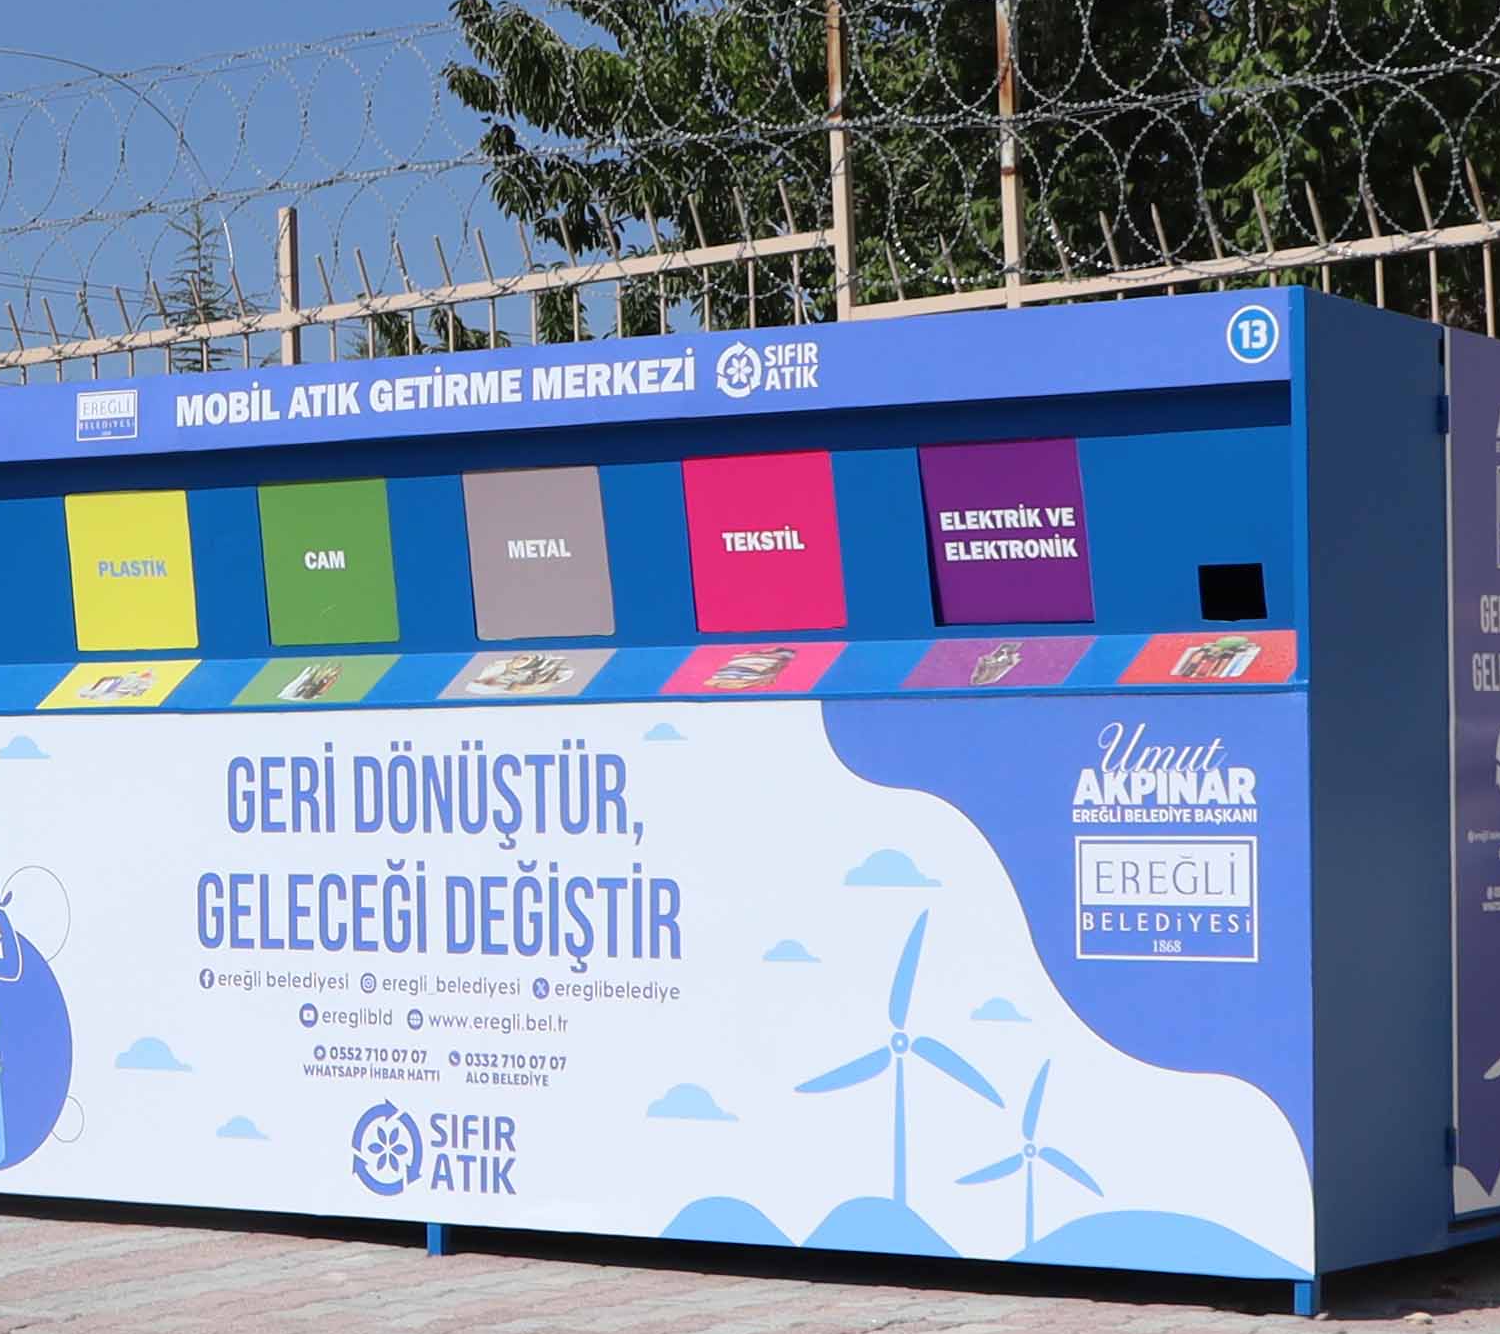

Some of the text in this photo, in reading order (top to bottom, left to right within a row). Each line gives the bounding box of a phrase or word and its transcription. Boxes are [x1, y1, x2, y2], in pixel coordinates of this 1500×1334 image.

[1237, 319, 1268, 350] 13
[764, 341, 819, 366] SIFIR
[175, 347, 696, 428] MOBİL ATIK GETİRME MERKEZİ
[764, 364, 819, 392] ATIK
[939, 503, 1076, 532] ELEKTRİK VE
[506, 537, 572, 560] METAL
[721, 525, 805, 553] TEKSTİL
[943, 533, 1079, 562] ELEKTRONİK
[97, 557, 168, 578] PLASTİK
[303, 550, 346, 570] CAM
[1097, 722, 1229, 773] Umut
[226, 739, 644, 850] GERİ DÖNÜŞTÜR,
[1072, 767, 1257, 805] AKPINAR
[1072, 805, 1257, 825] EREĞLİ BELEDİYE BAŞKANI
[1095, 851, 1237, 896] EREĞLİ
[197, 858, 683, 973] GELECEĞİ DEĞİŞTİR
[1152, 939, 1182, 953] 1868
[217, 970, 350, 994] ereğli belediyesi
[554, 980, 681, 1003] ereglibelediye
[321, 1008, 393, 1029] ereglibld
[428, 1013, 569, 1035] www.eregli.bel.tr
[329, 1045, 428, 1064] 0552 710 07 07
[464, 1052, 567, 1071] 0332 710 07 07
[303, 1063, 440, 1082] WHATSAPP İHBAR HATTI
[465, 1070, 550, 1087] ALO BELEDİYE
[429, 1113, 517, 1153] SIFIR
[430, 1153, 518, 1196] ATIK
